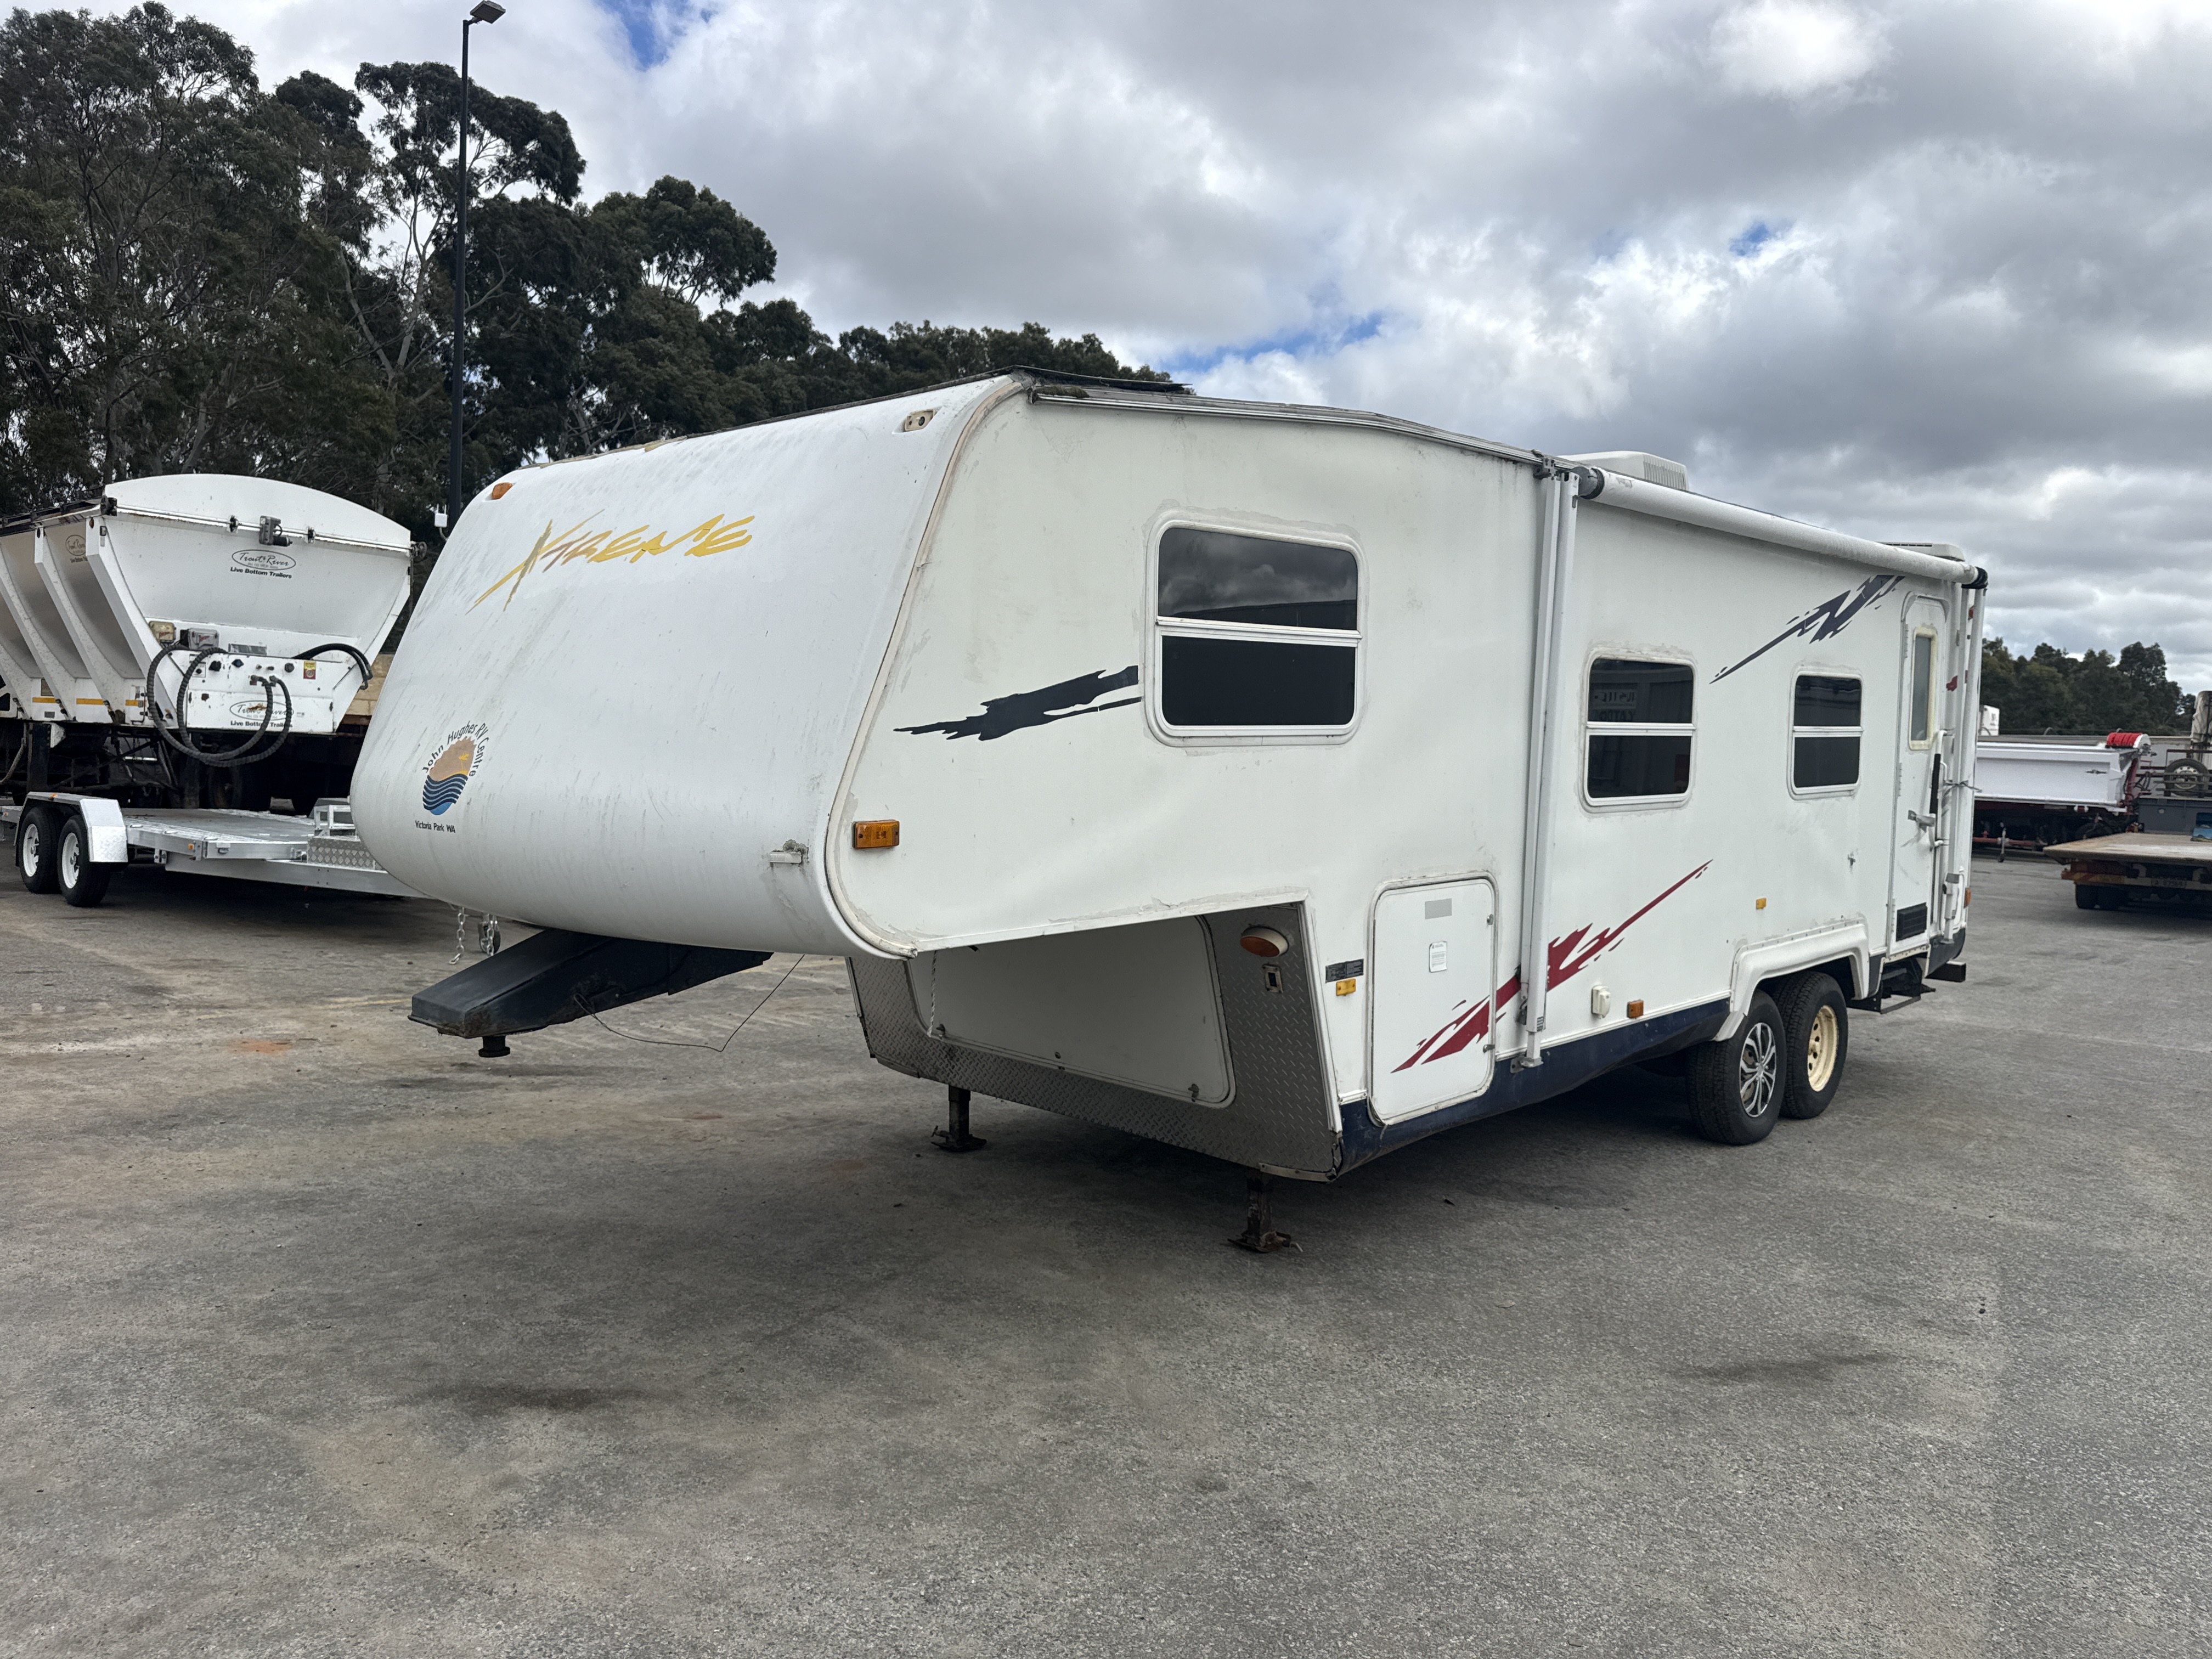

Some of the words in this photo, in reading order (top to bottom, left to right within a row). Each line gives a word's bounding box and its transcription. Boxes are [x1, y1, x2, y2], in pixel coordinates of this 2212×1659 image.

[239, 552, 264, 563] Trout
[266, 555, 290, 566] River
[447, 720, 478, 745] Hughes
[475, 723, 488, 740] RV
[422, 745, 443, 773] John
[469, 737, 489, 777] Centre
[415, 820, 432, 830] Victoria
[433, 823, 444, 832] Park
[446, 825, 455, 833] WA
